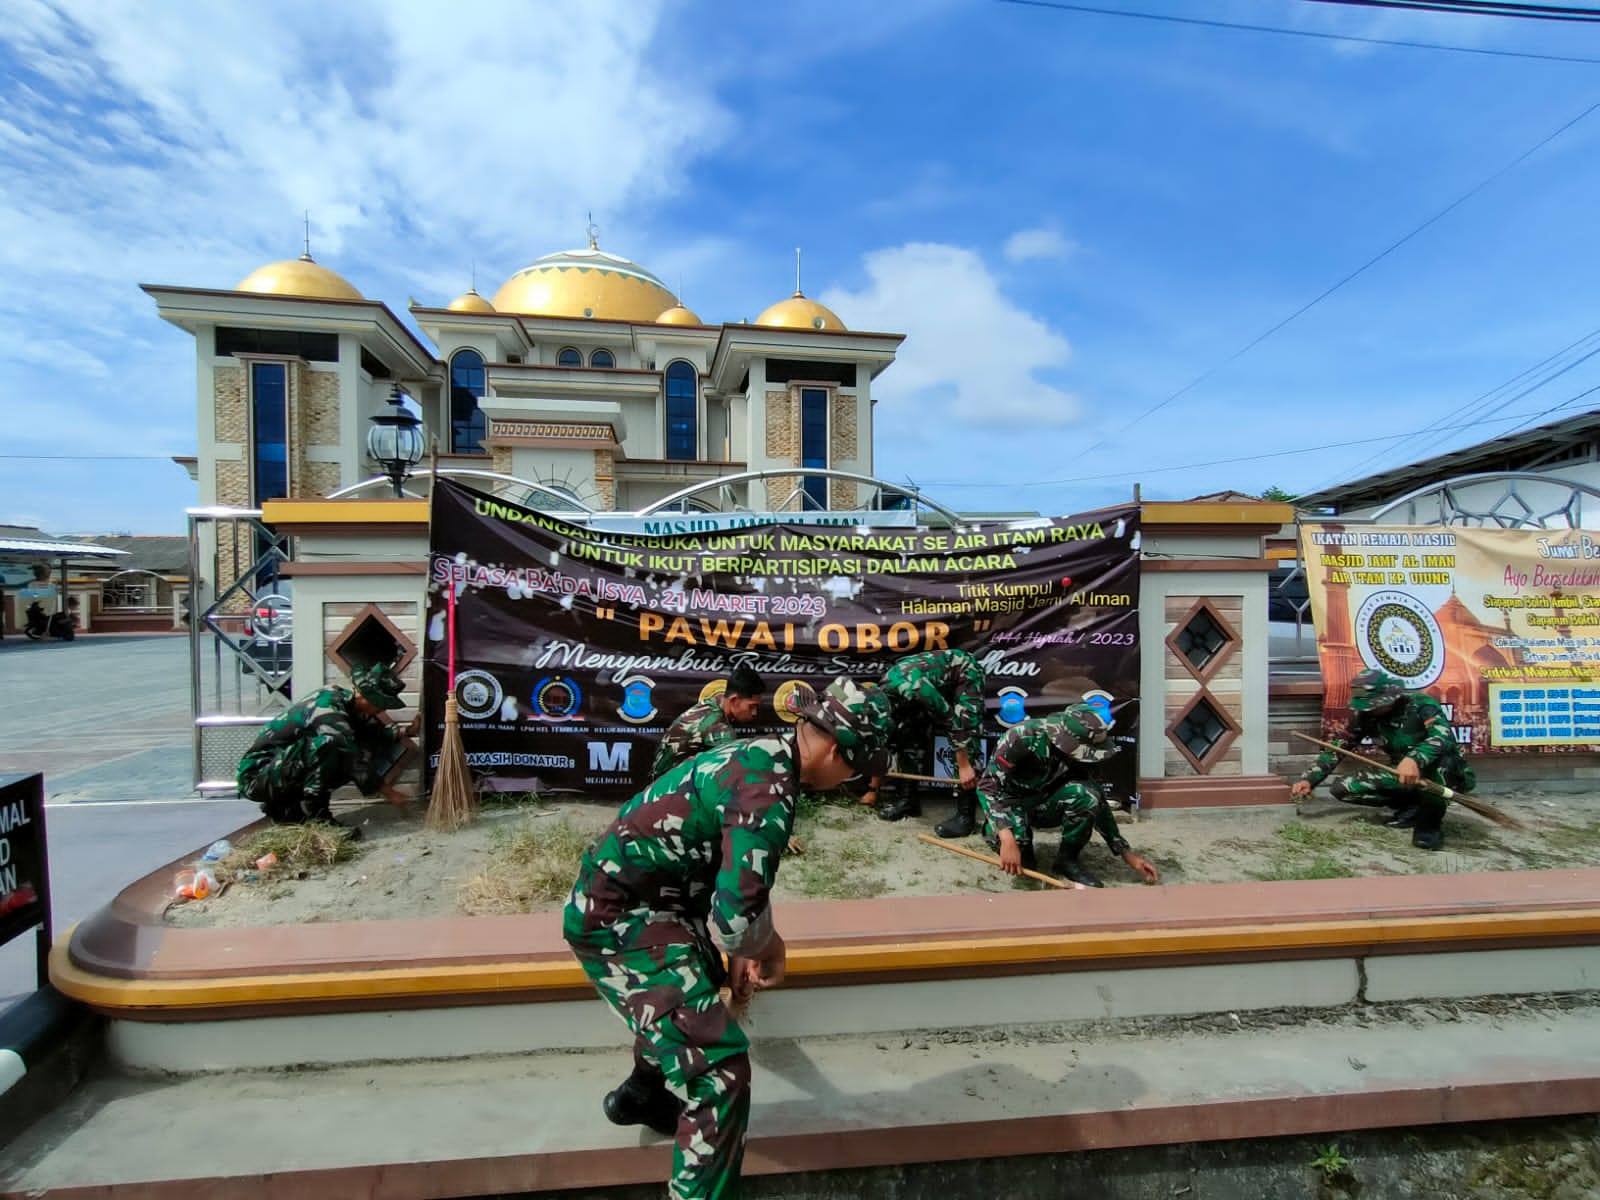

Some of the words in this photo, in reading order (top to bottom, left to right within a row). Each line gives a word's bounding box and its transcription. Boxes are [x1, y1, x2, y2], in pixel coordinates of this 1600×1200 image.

[475, 498, 600, 542] UNDANGAN
[607, 535, 701, 551] TERBUKA
[707, 534, 775, 551] UNTUK
[780, 535, 917, 551] MASYARAKAT
[922, 536, 948, 551] SE
[953, 534, 988, 549] AIR
[993, 528, 1047, 546] ITAM
[1050, 522, 1106, 542] RAYA
[1312, 533, 1358, 546] IKATAN
[1361, 533, 1410, 546] REMAJA
[1413, 533, 1456, 546] MASJID
[570, 541, 645, 567] UNTUK
[649, 557, 697, 572] IKUT
[702, 558, 862, 576] BERPARTISIPASI
[866, 558, 940, 574] DALAM
[944, 554, 1017, 571] ACARA
[1321, 554, 1365, 568] MASJID
[1402, 554, 1420, 568] AL
[1422, 554, 1456, 568] IMAN
[433, 558, 520, 588] SELASA
[526, 568, 593, 597] BA'DA
[661, 589, 686, 608] 21
[691, 588, 768, 613] MARET
[772, 596, 827, 617] 2023
[956, 582, 991, 598] Titik
[994, 580, 1053, 598] Kumpul
[1331, 572, 1352, 584] AIR
[1354, 572, 1386, 584] ITAM
[1409, 572, 1450, 584] UJUNG
[1503, 564, 1528, 595] Ayo
[901, 598, 970, 615] Halaman
[975, 596, 1025, 614] Masjid
[1070, 593, 1086, 606] Al
[1090, 592, 1130, 606] Iman
[639, 612, 795, 650] PAWAI
[818, 621, 950, 653] OBOR
[1090, 632, 1136, 646] 2023
[535, 640, 724, 683] Menyambut
[729, 648, 816, 674] Bulan
